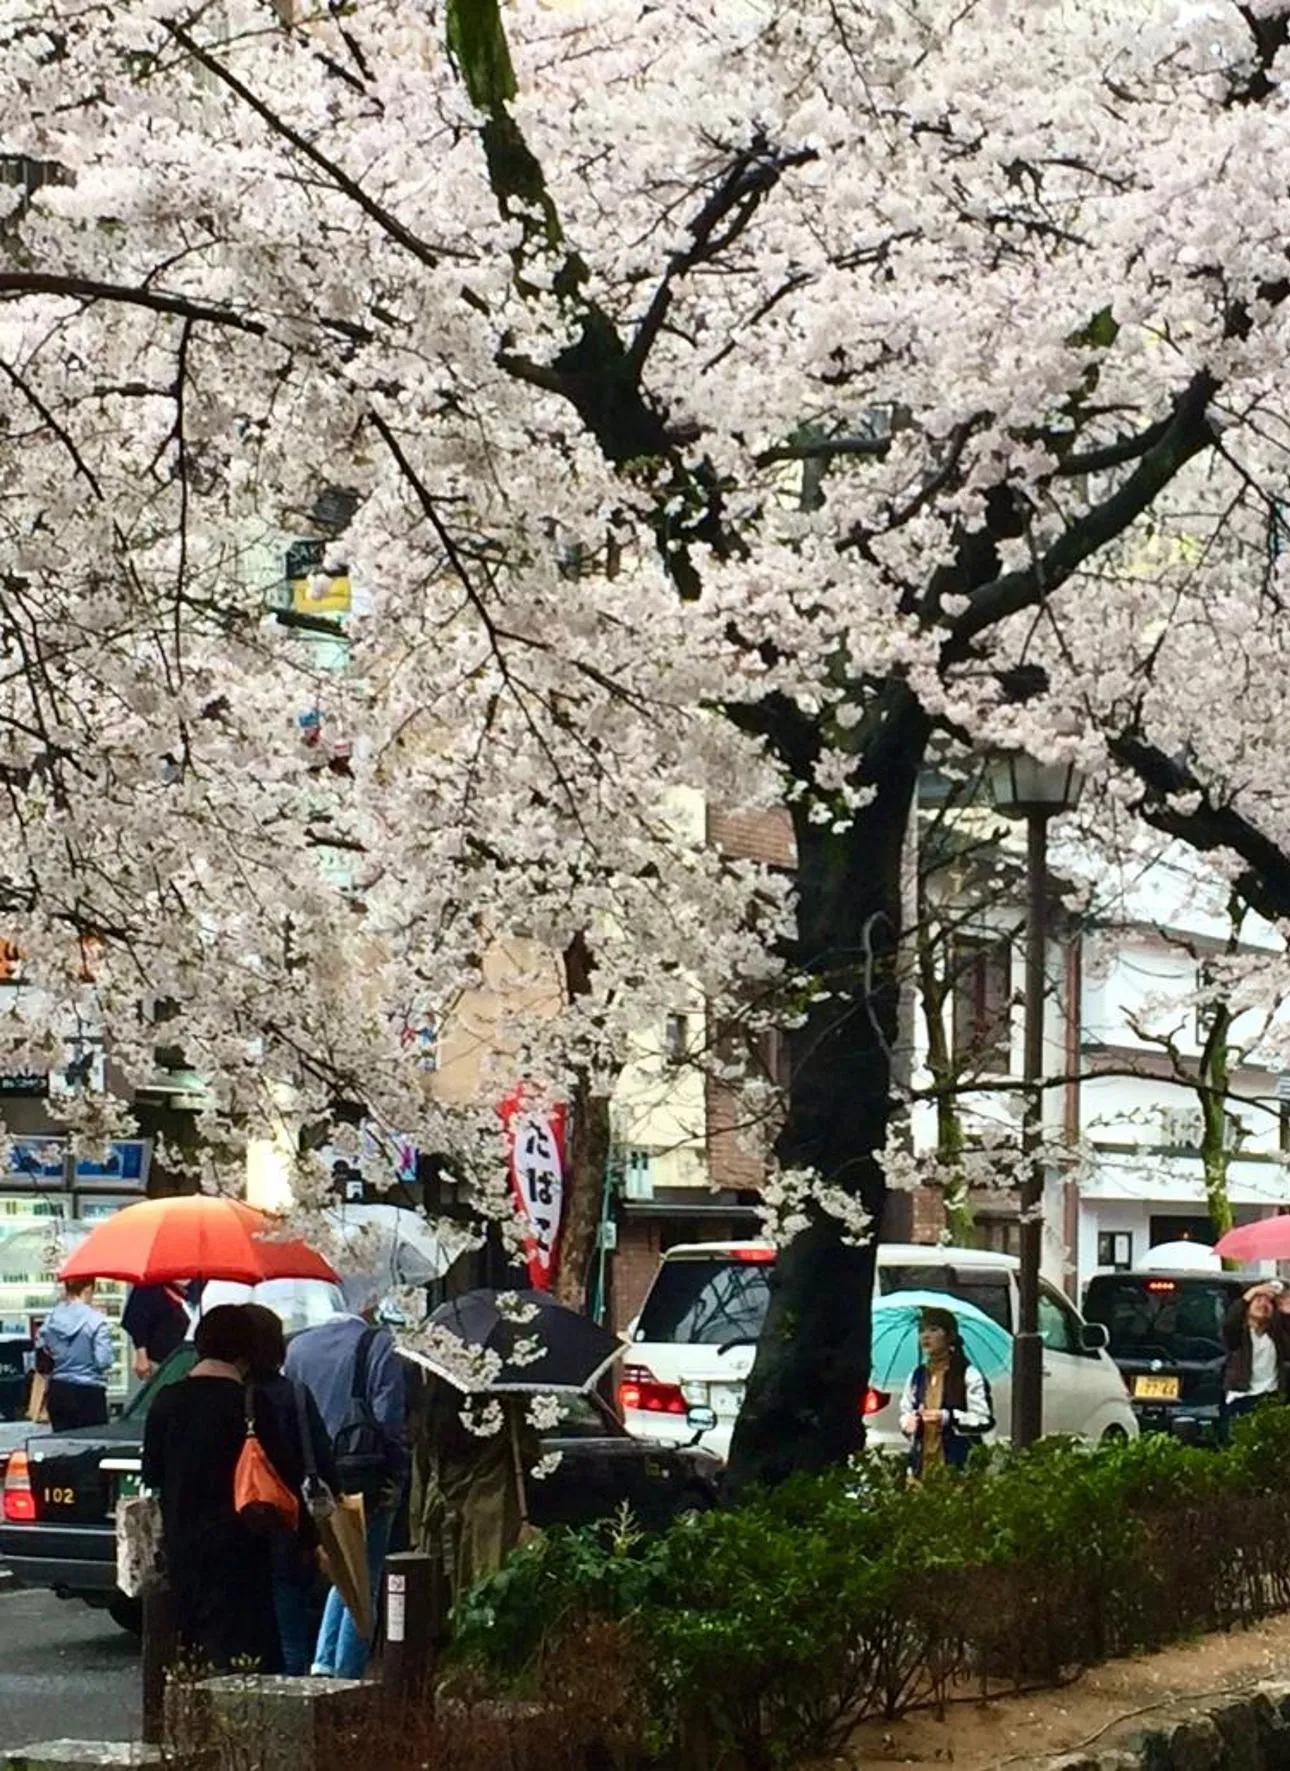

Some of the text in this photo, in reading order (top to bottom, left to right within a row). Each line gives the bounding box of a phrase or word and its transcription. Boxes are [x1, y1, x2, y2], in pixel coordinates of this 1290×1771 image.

[525, 1119, 556, 1252] たばこ
[44, 1487, 75, 1504] 102
